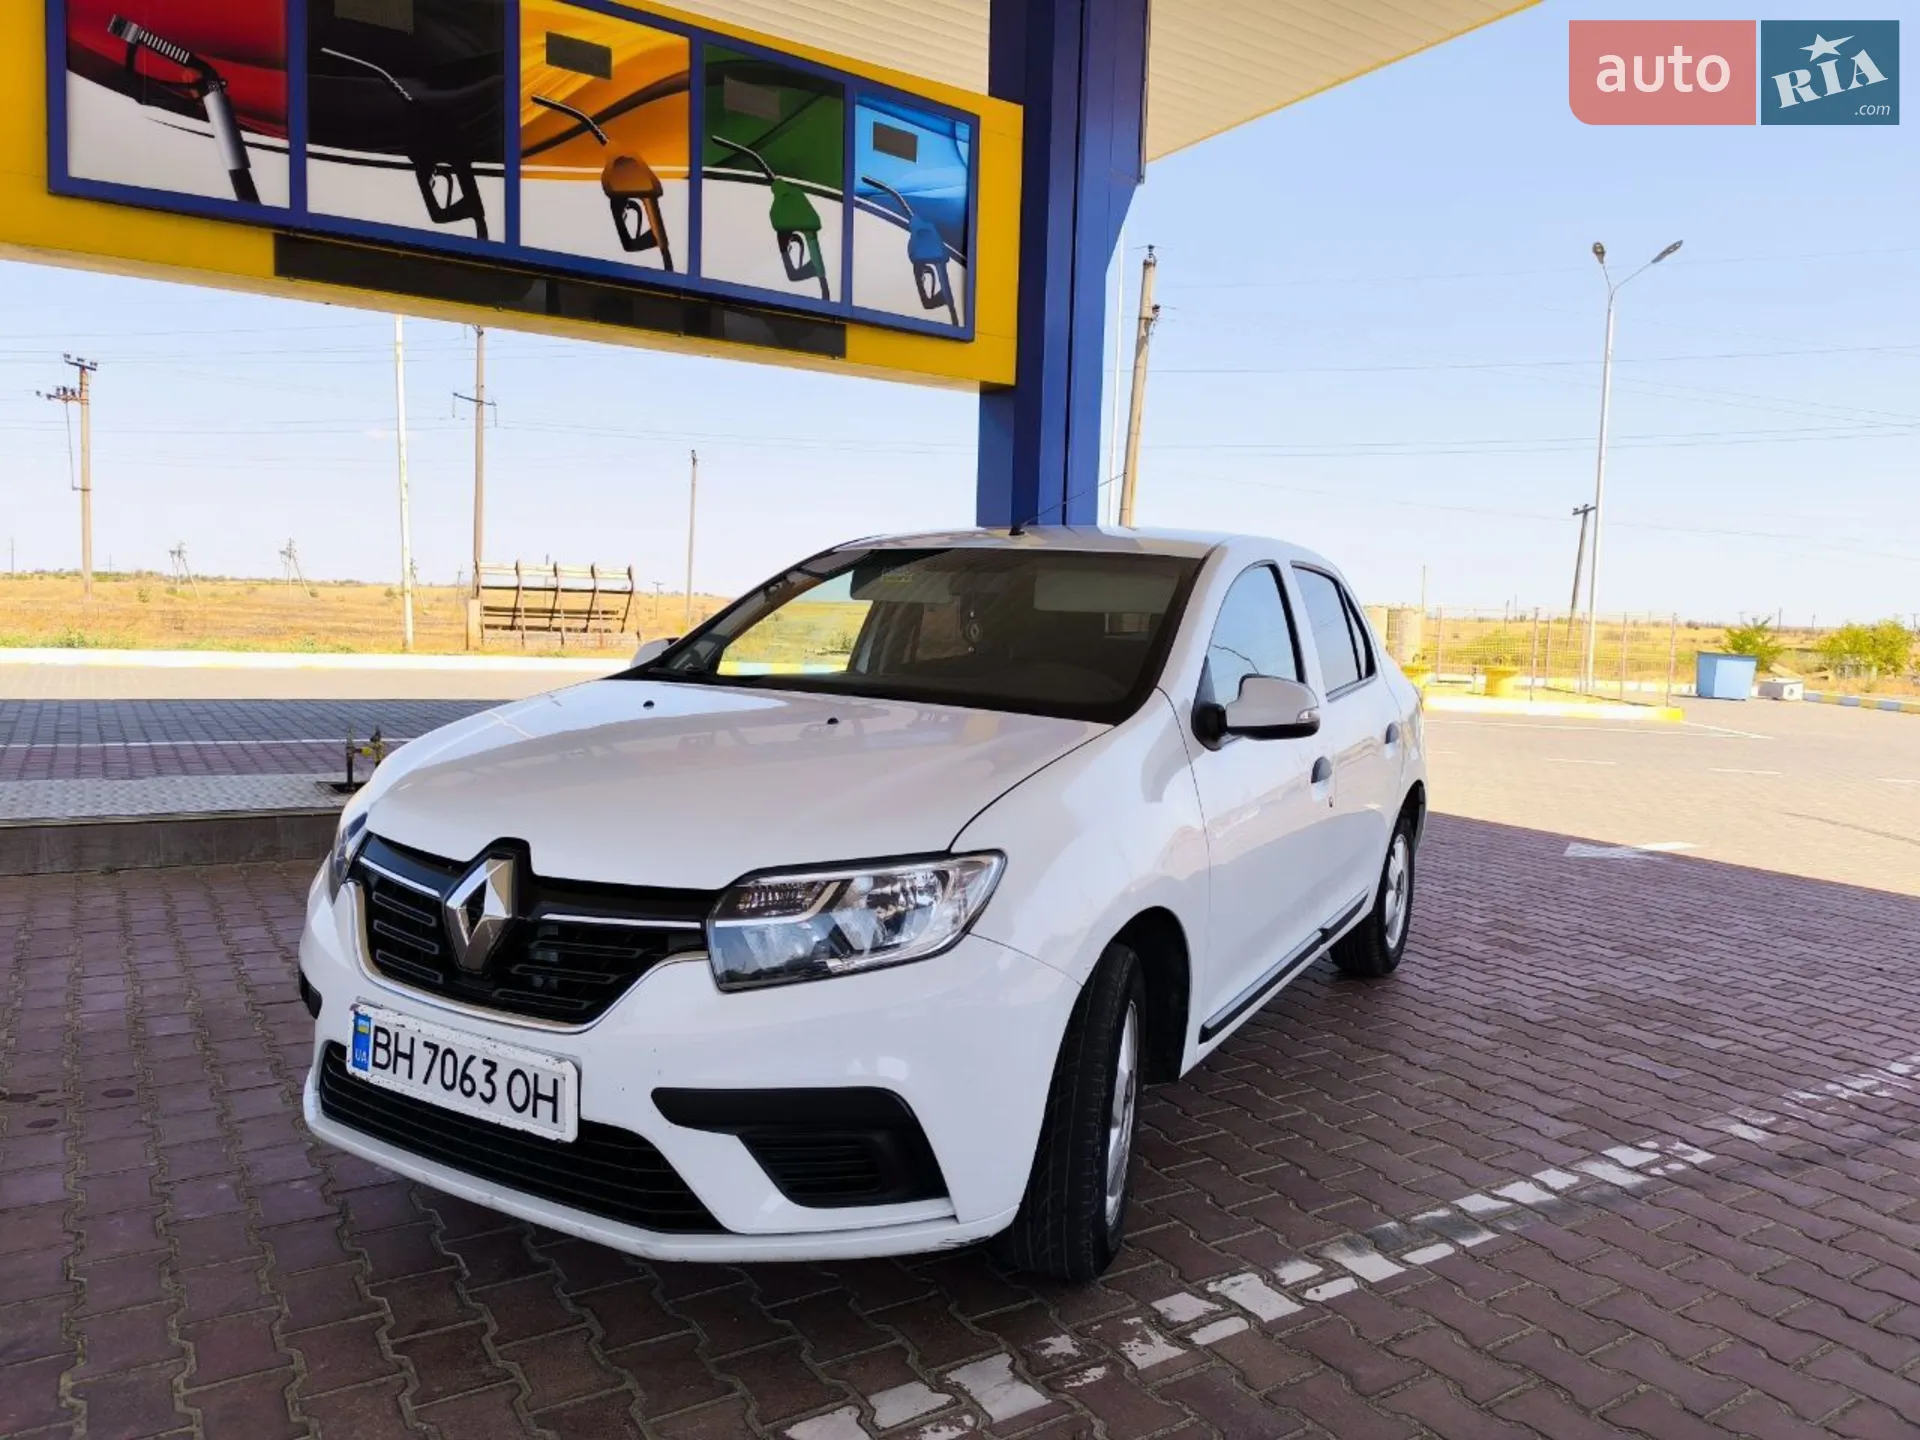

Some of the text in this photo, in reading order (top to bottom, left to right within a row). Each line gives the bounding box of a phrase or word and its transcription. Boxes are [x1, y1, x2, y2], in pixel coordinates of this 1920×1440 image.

[354, 1048, 369, 1064] UA
[372, 1025, 559, 1124] BH 7063 OH
